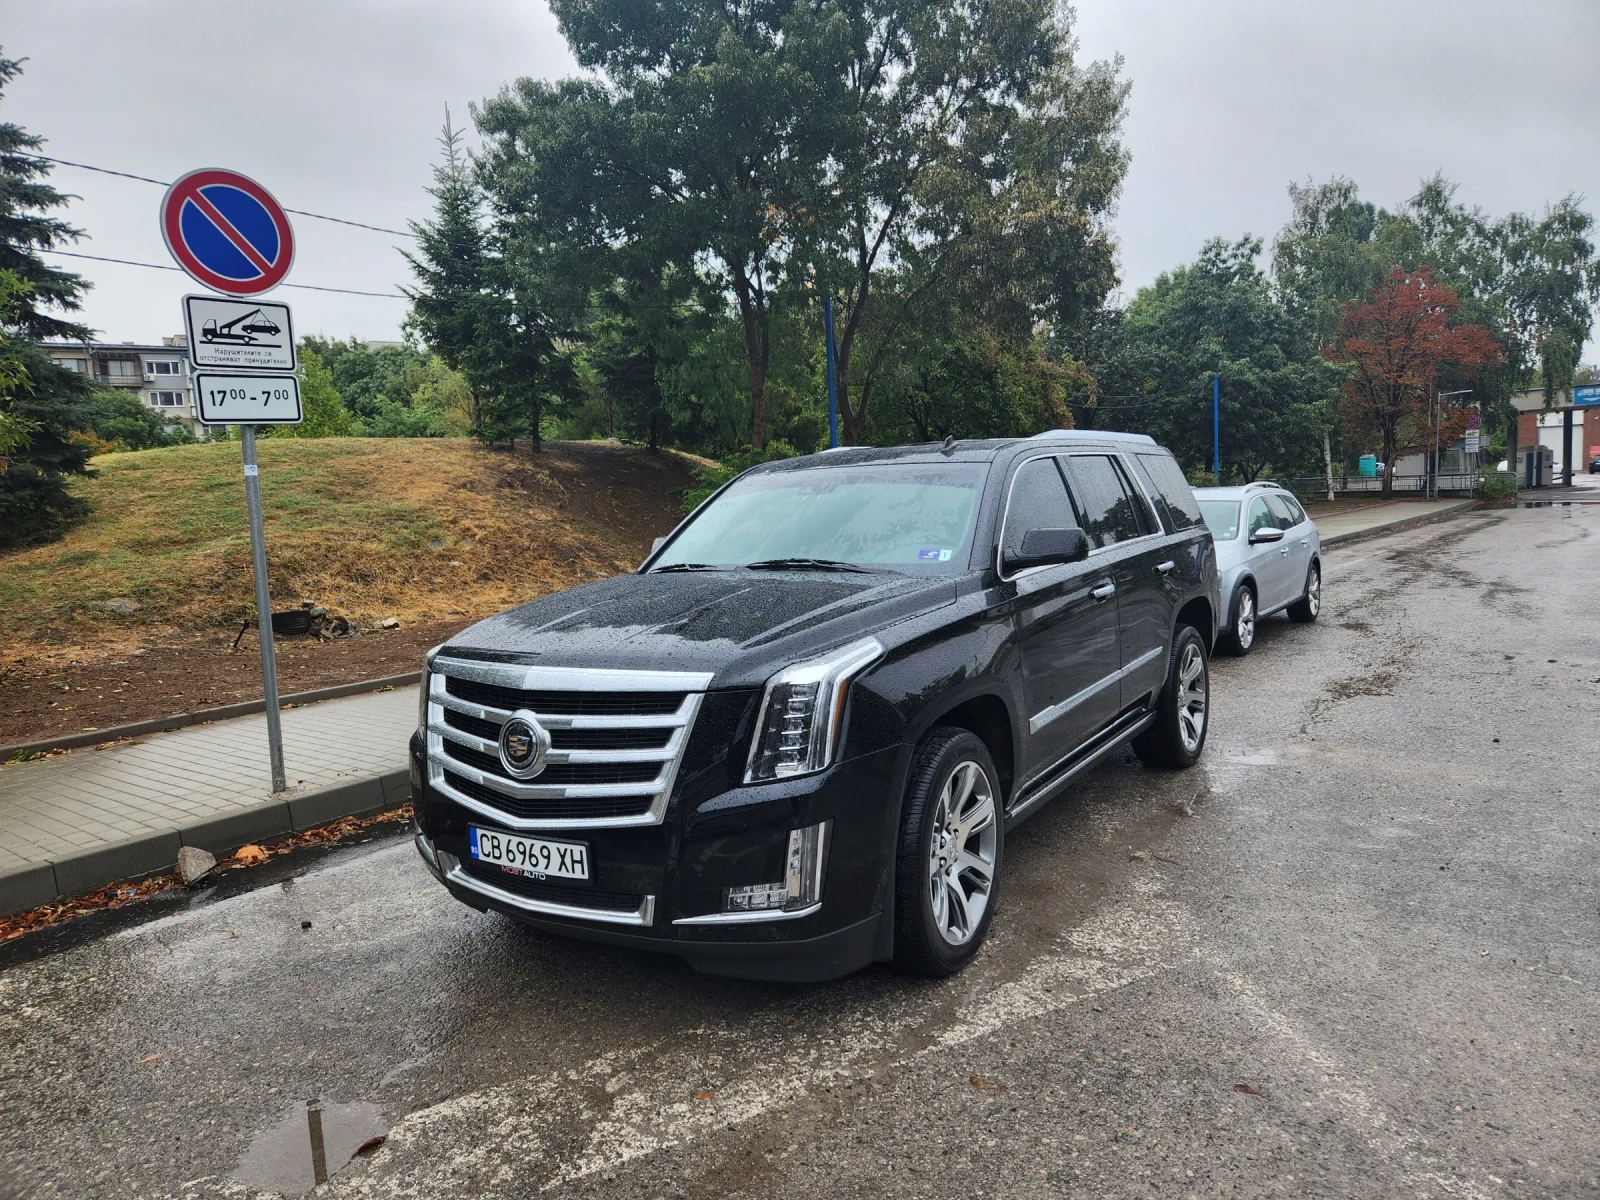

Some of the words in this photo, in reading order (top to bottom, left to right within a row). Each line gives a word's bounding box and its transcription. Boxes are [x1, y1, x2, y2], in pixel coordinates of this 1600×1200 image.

[214, 348, 261, 357] Нарушителите
[470, 845, 479, 855] BG
[479, 833, 502, 860] CB
[506, 839, 551, 870] 6969
[556, 846, 585, 875] XH
